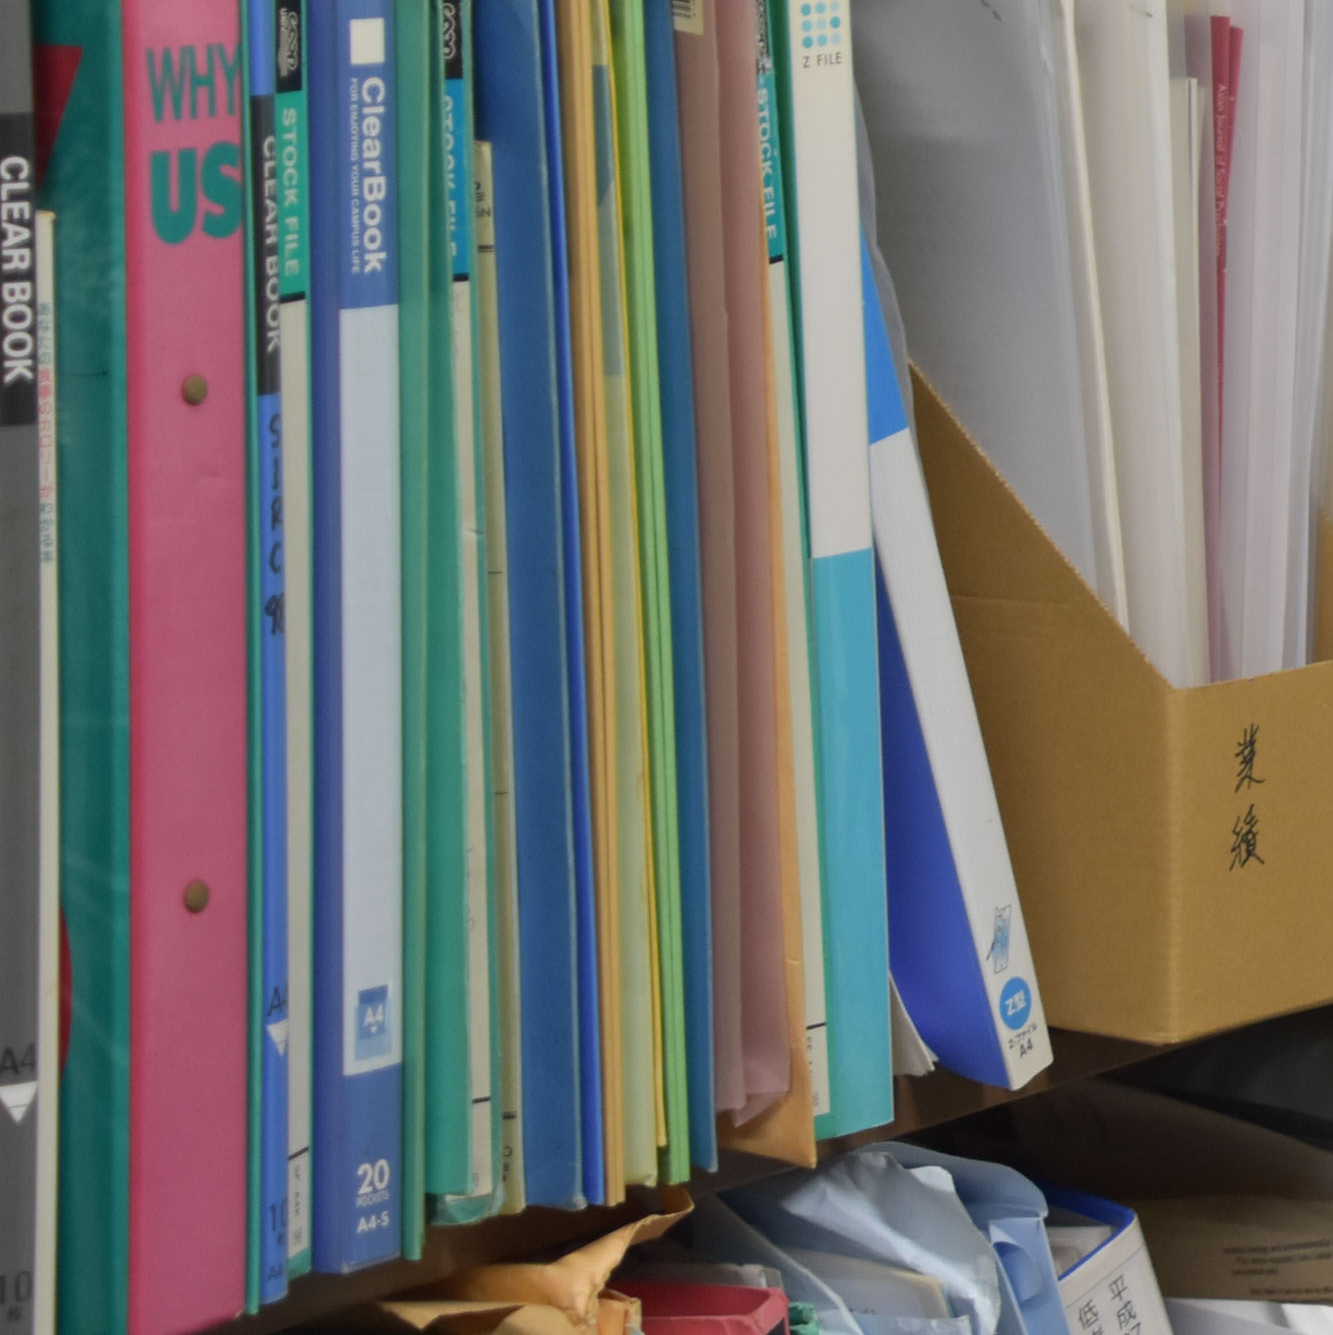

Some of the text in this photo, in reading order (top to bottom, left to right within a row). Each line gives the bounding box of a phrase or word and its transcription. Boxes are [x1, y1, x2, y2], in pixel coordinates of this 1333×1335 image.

[803, 51, 843, 69] Z FILE
[146, 41, 242, 123] WHY
[150, 140, 243, 245] US
[282, 106, 301, 276] STOCK FILE
[349, 77, 360, 274] FOR ENJOYING YOUR CAMPUS LIFE
[360, 76, 387, 274] ClearBook
[0, 155, 34, 385] CLEAR BOOK
[363, 1005, 385, 1027] A4
[0, 1043, 36, 1077] A4
[1020, 1038, 1034, 1059] A4
[357, 1158, 391, 1197] 20
[355, 1191, 391, 1209] POCKETS
[357, 1209, 391, 1234] A4-S
